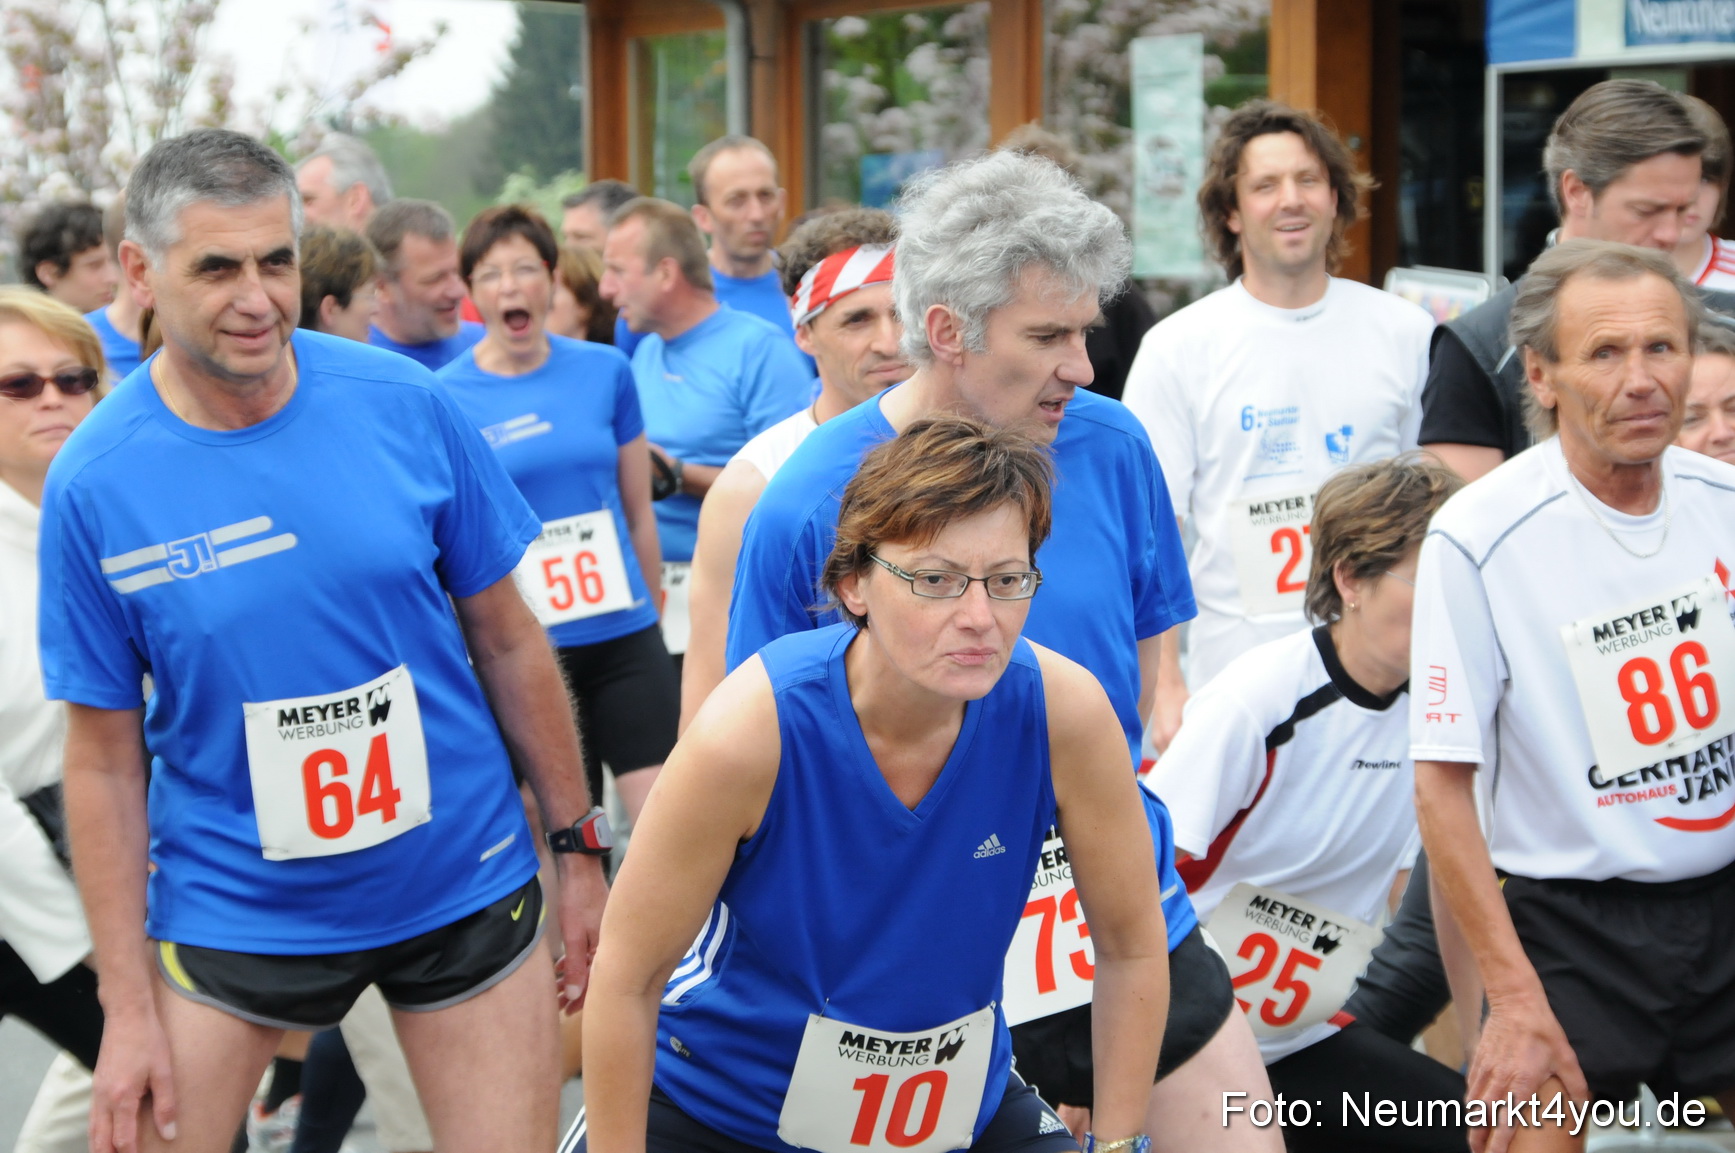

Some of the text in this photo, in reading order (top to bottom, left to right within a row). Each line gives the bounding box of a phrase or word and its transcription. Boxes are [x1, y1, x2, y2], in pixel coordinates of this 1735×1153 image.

[1249, 496, 1305, 516] MEYER
[1271, 524, 1311, 594] 2
[541, 550, 605, 611] 56
[1592, 604, 1670, 643] MEYER
[1597, 623, 1674, 655] WERBUNG
[1617, 640, 1721, 746] 86
[277, 697, 361, 728] MEYER
[278, 715, 364, 741] WERBUNG
[302, 732, 402, 840] 64
[1597, 784, 1678, 808] AUTOHAUS
[1677, 755, 1735, 805] JÄN
[973, 845, 1006, 859] adidas
[1245, 908, 1311, 943] WERBUNG
[1249, 895, 1317, 930] MEYER
[1021, 887, 1095, 995] 73
[1232, 932, 1323, 1027] 25
[838, 1046, 929, 1067] WERBUNG
[839, 1030, 932, 1055] MEYER
[850, 1070, 948, 1148] 10
